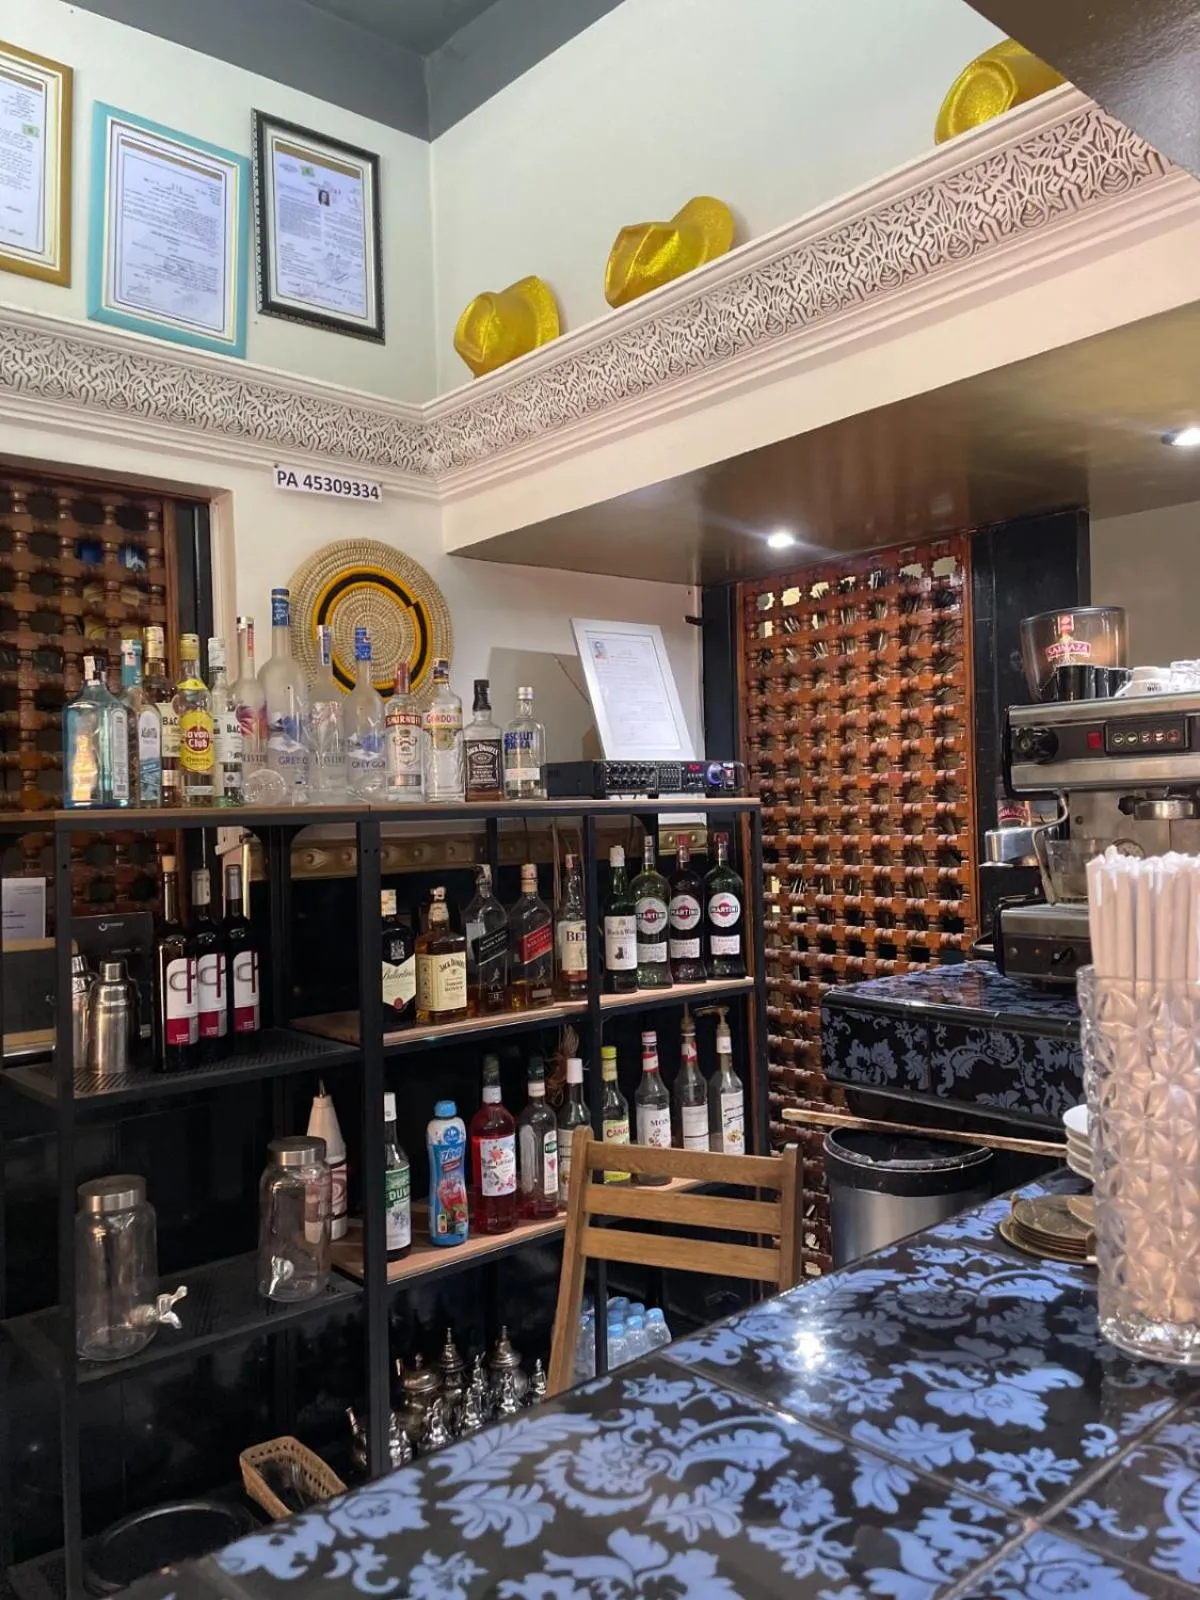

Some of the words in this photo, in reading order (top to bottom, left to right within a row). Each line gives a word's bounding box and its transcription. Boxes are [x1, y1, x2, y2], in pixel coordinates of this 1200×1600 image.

[277, 470, 299, 488] PA
[303, 474, 379, 500] 45309334
[670, 908, 699, 917] MARTINI
[710, 906, 739, 915] MARTINI
